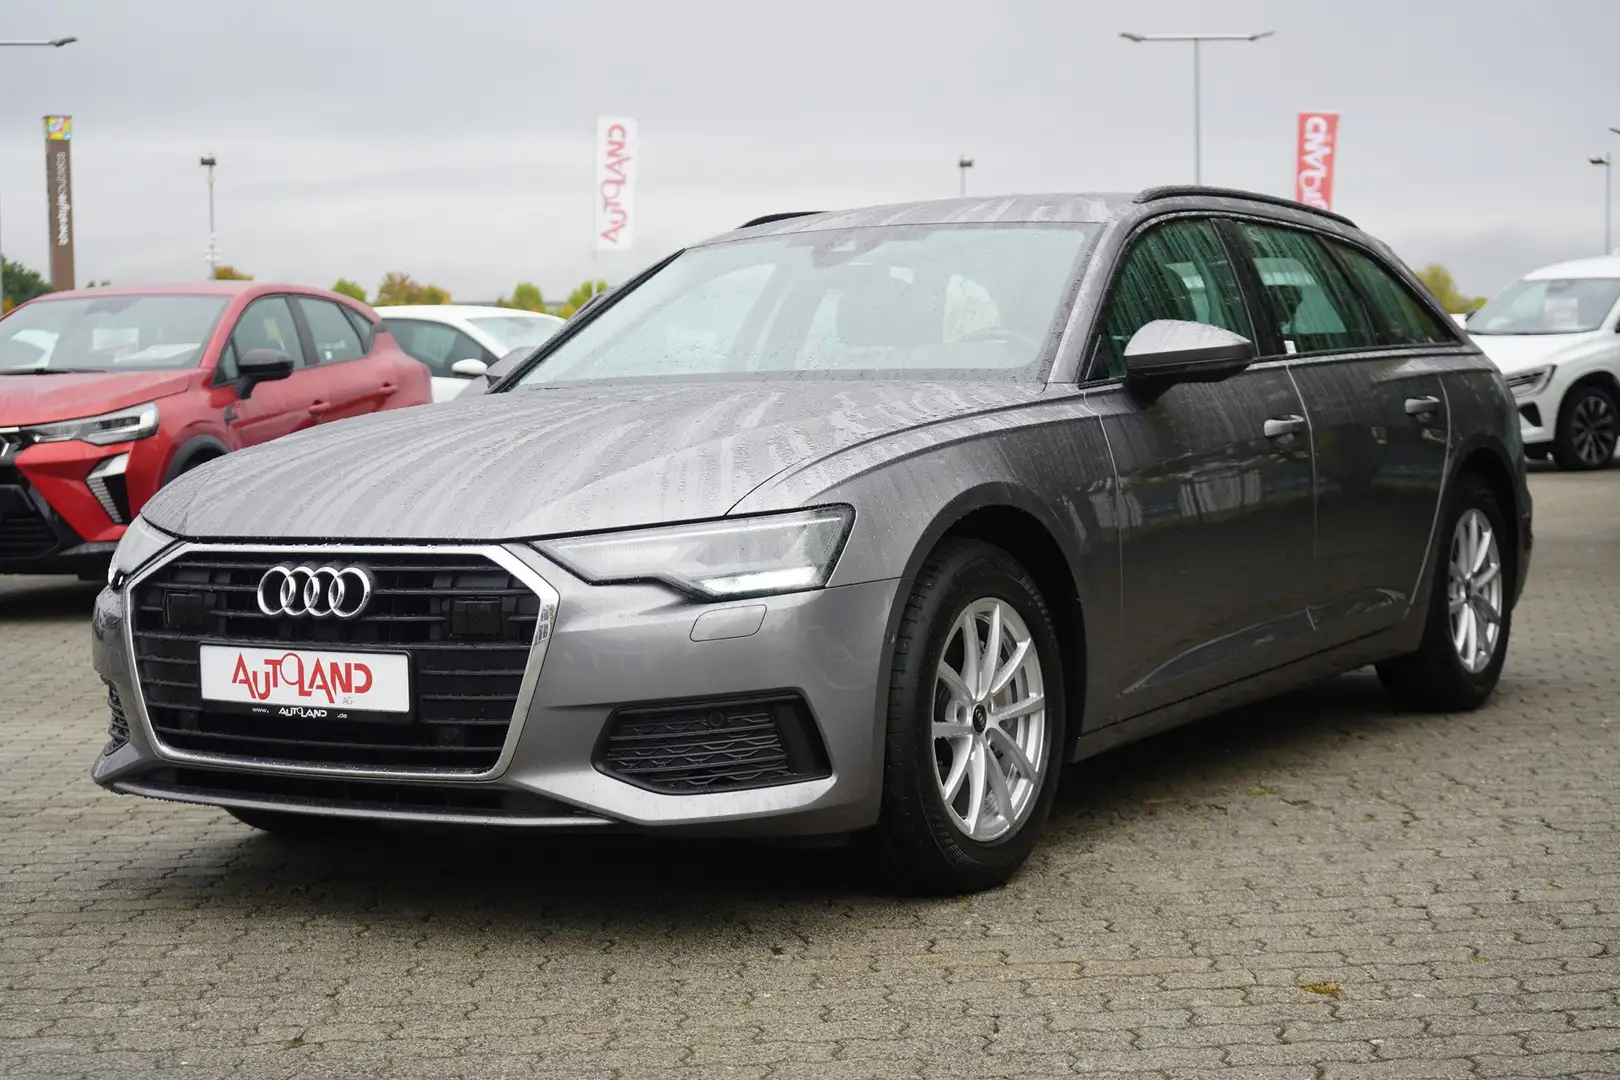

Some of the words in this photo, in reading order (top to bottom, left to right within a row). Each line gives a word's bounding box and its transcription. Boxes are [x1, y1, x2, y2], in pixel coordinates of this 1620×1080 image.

[600, 124, 632, 244] AUTOLAND
[1299, 116, 1332, 211] UTOLAND
[231, 652, 373, 704] AUTOLAND
[343, 696, 353, 705] AG
[279, 707, 327, 719] AUTOLAND
